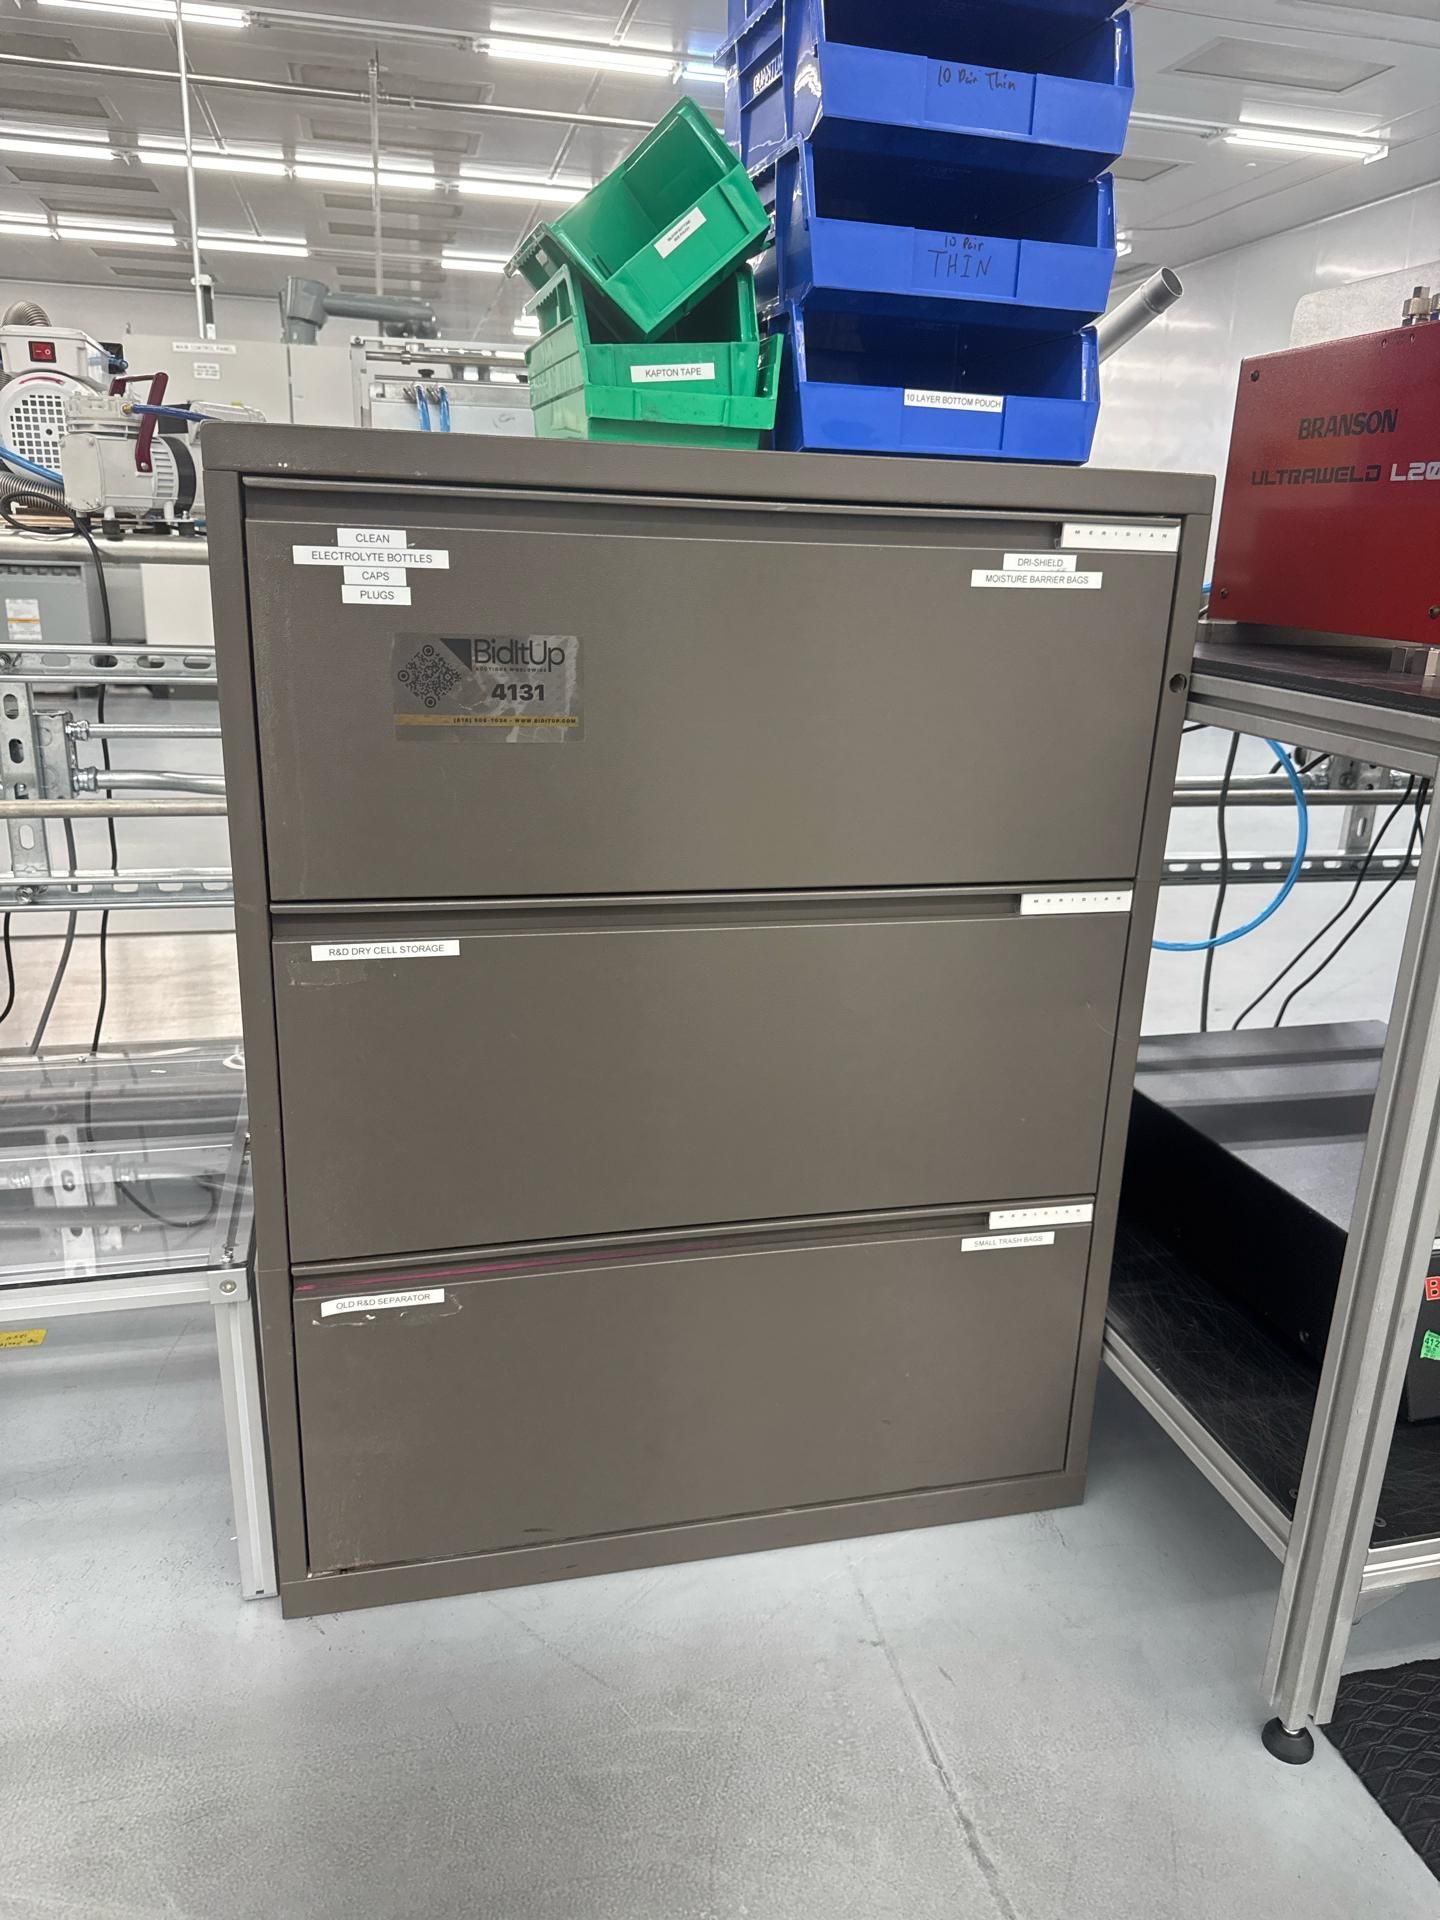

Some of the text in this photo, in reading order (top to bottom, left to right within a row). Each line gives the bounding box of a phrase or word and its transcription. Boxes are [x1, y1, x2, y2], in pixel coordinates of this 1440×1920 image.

[938, 66, 951, 87] 10
[985, 72, 1016, 91] Thin
[945, 235, 956, 248] 10
[928, 250, 992, 278] THIN
[645, 367, 702, 378] KAPTON TAPE
[906, 393, 1000, 408] 10 LAYER BOTTOM POUCH
[1298, 409, 1399, 440] BRANSON
[1251, 465, 1382, 486] ULTRAWELD
[355, 533, 390, 544] CLEAN
[1074, 529, 1168, 538] MERIDIAN
[311, 550, 433, 563] ELECTROLYTE BOTTLES
[1017, 558, 1064, 568] DRI-SHIELD
[361, 571, 390, 581] CAPS
[985, 575, 1089, 585] MOISTURE BARRIER BAGS
[360, 590, 394, 600] PLUGS
[474, 638, 565, 673] BidItUp
[491, 684, 545, 701] 4131
[328, 944, 445, 956] R&D DRY CELL STORAGE
[973, 1235, 1043, 1248] SMALL TRASH BAGS
[335, 1293, 431, 1310] OLD R&D SEPARATOR
